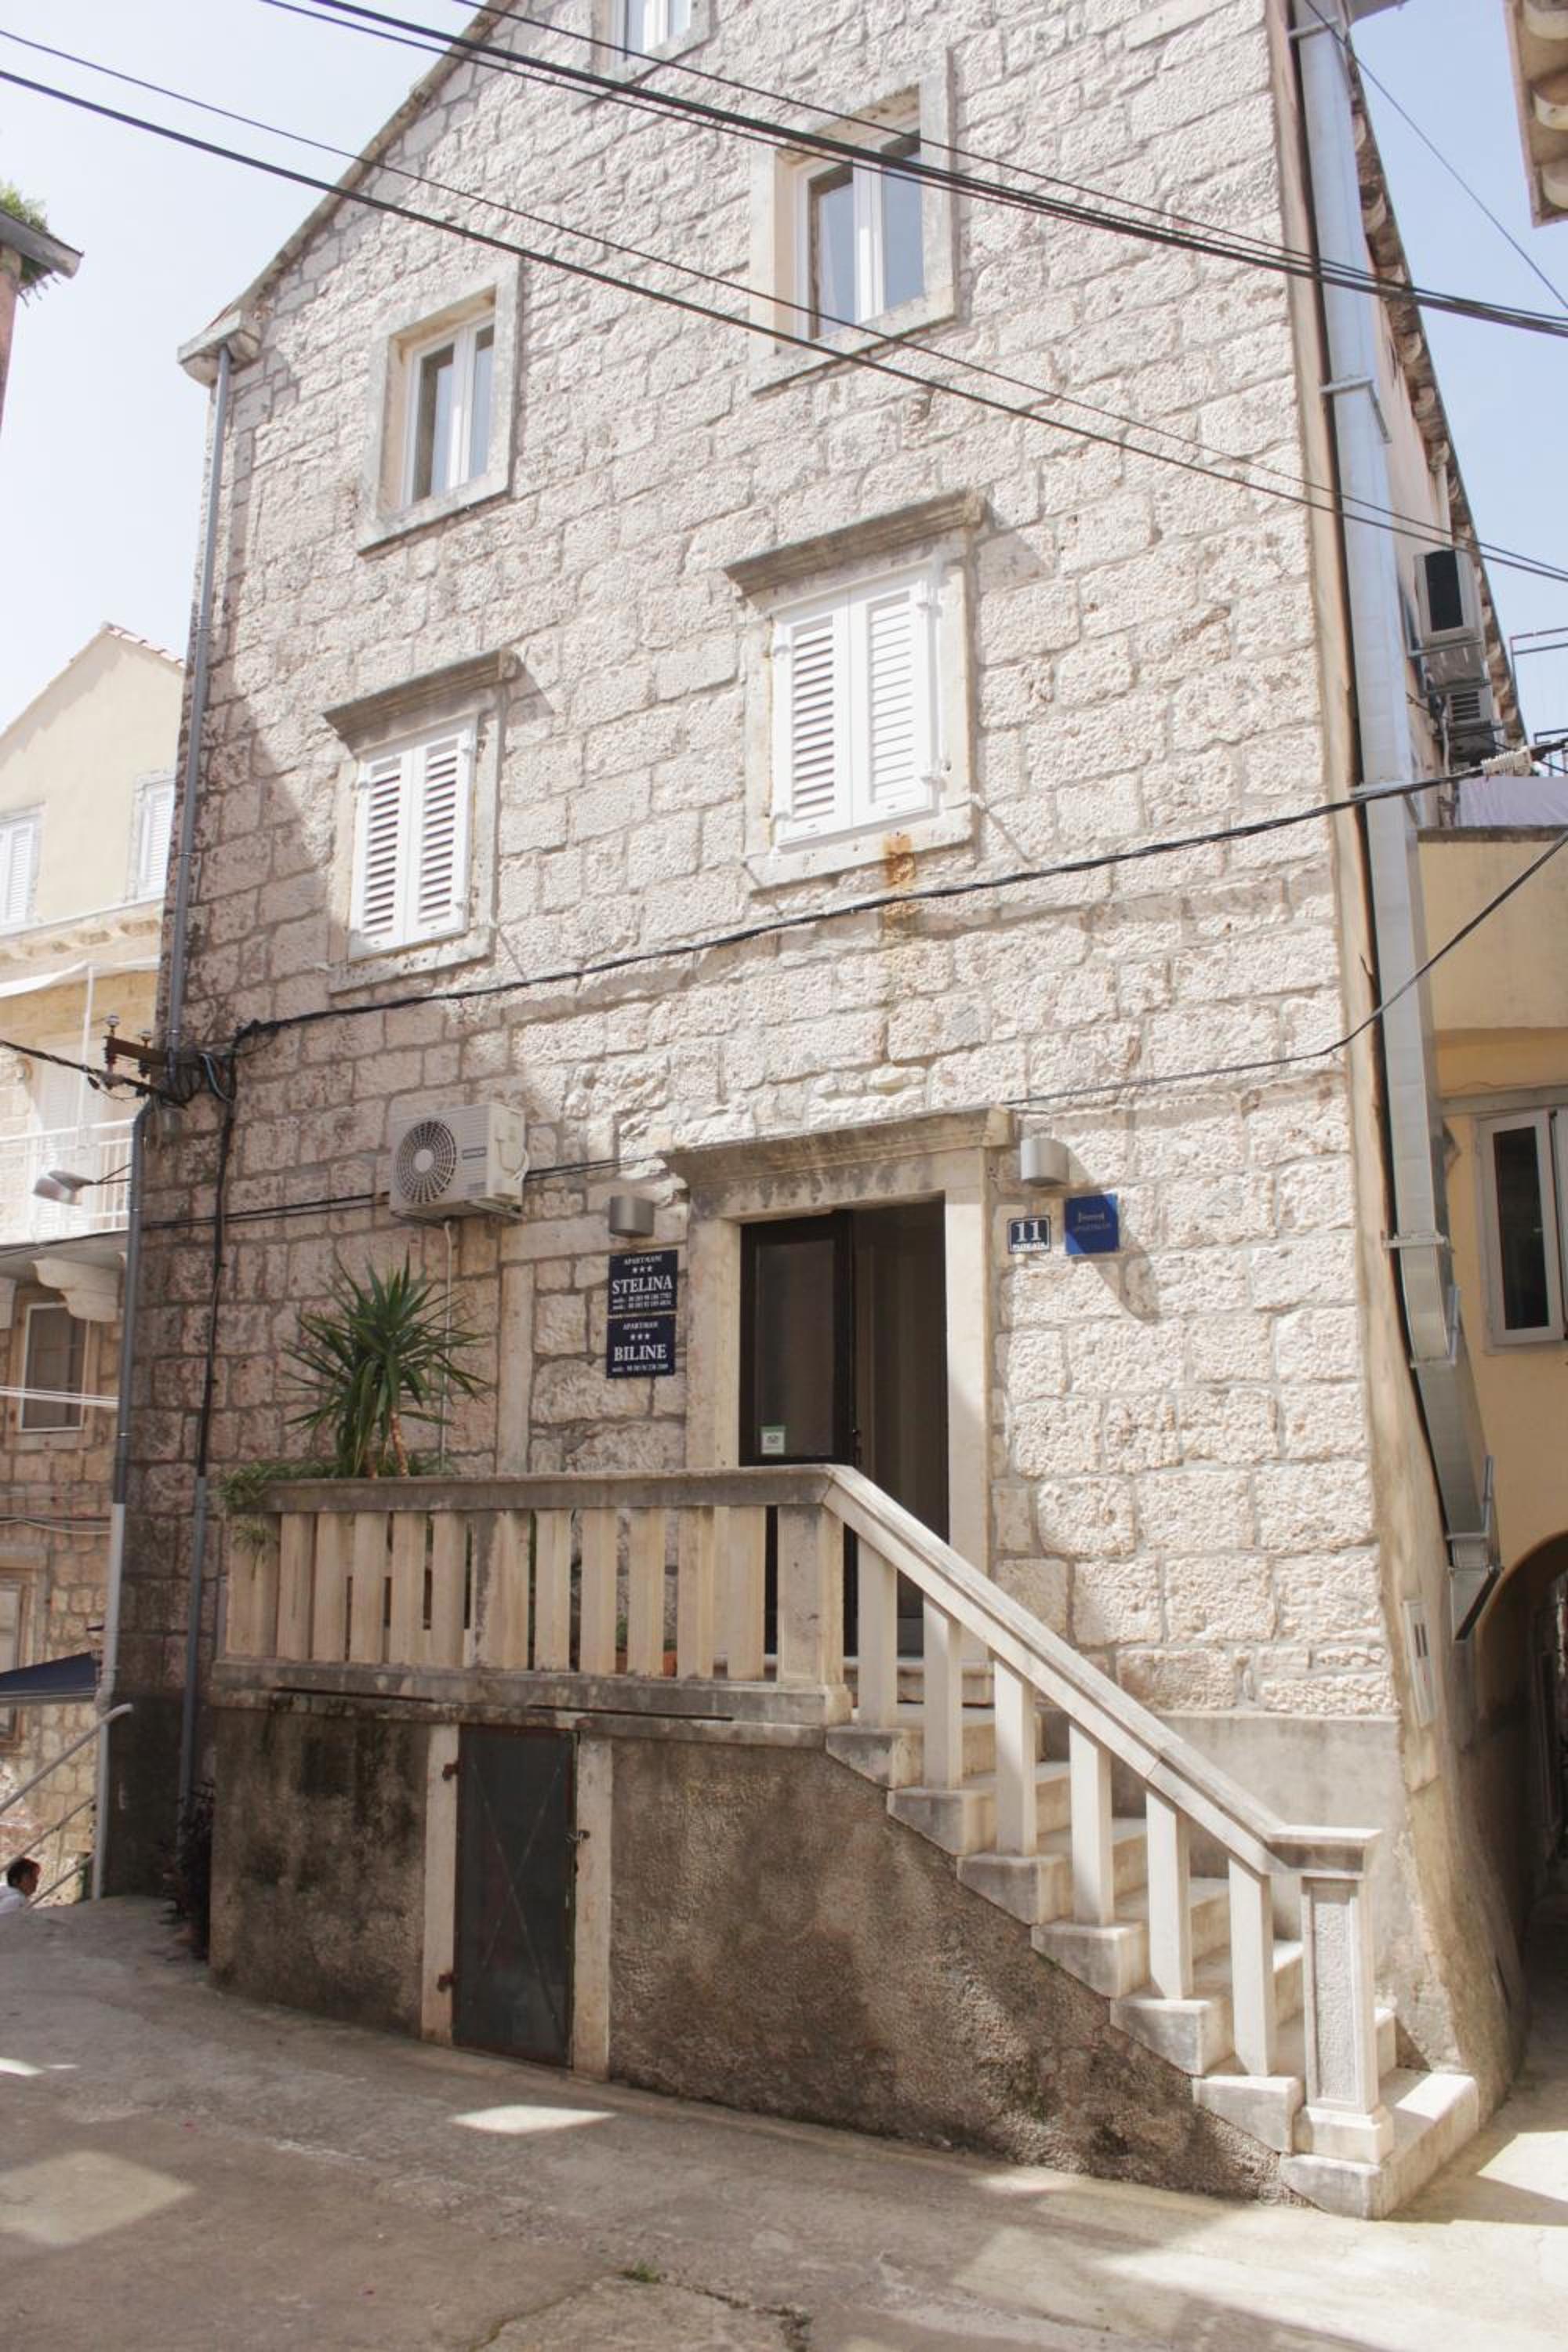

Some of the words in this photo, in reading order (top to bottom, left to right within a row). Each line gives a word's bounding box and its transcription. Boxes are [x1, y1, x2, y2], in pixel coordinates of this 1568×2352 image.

[1014, 1221, 1042, 1243] 11
[612, 1275, 673, 1294] STELINA
[614, 1344, 667, 1362] BILINE
